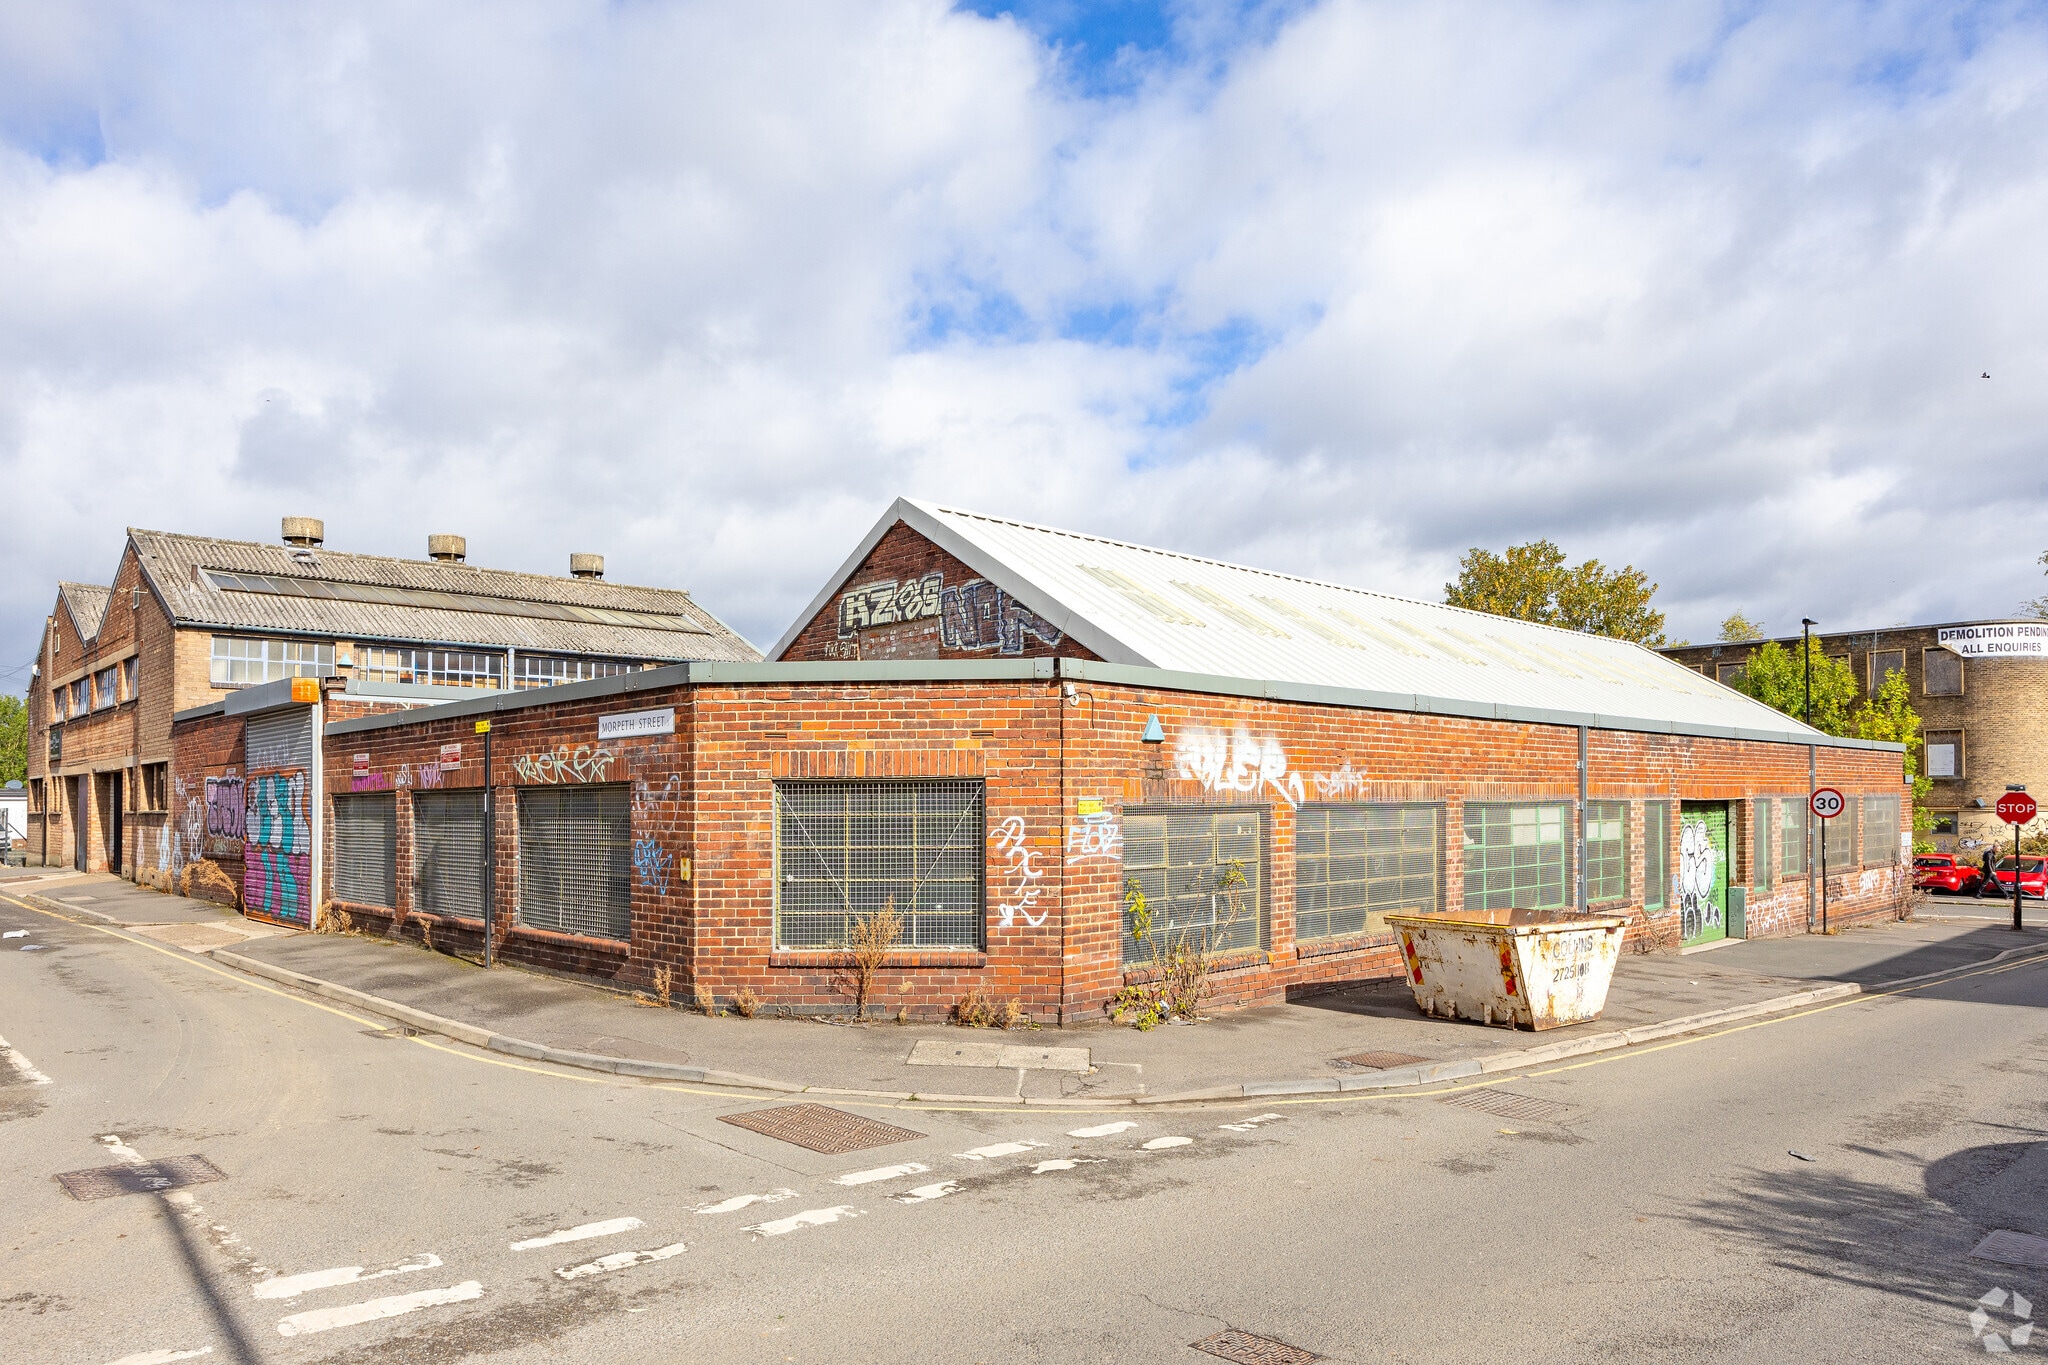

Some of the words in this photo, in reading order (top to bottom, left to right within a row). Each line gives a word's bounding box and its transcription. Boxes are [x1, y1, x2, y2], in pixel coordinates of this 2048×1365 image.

[1940, 627, 2014, 641] DEMOLITION
[2017, 626, 2048, 637] PENDIN
[1961, 644, 1984, 654] ALL
[1987, 642, 2042, 653] ENQUIRIES
[602, 719, 635, 733] MORPETH
[638, 716, 665, 729] STREET
[1815, 797, 1839, 810] 30
[1998, 803, 2036, 814] STOP
